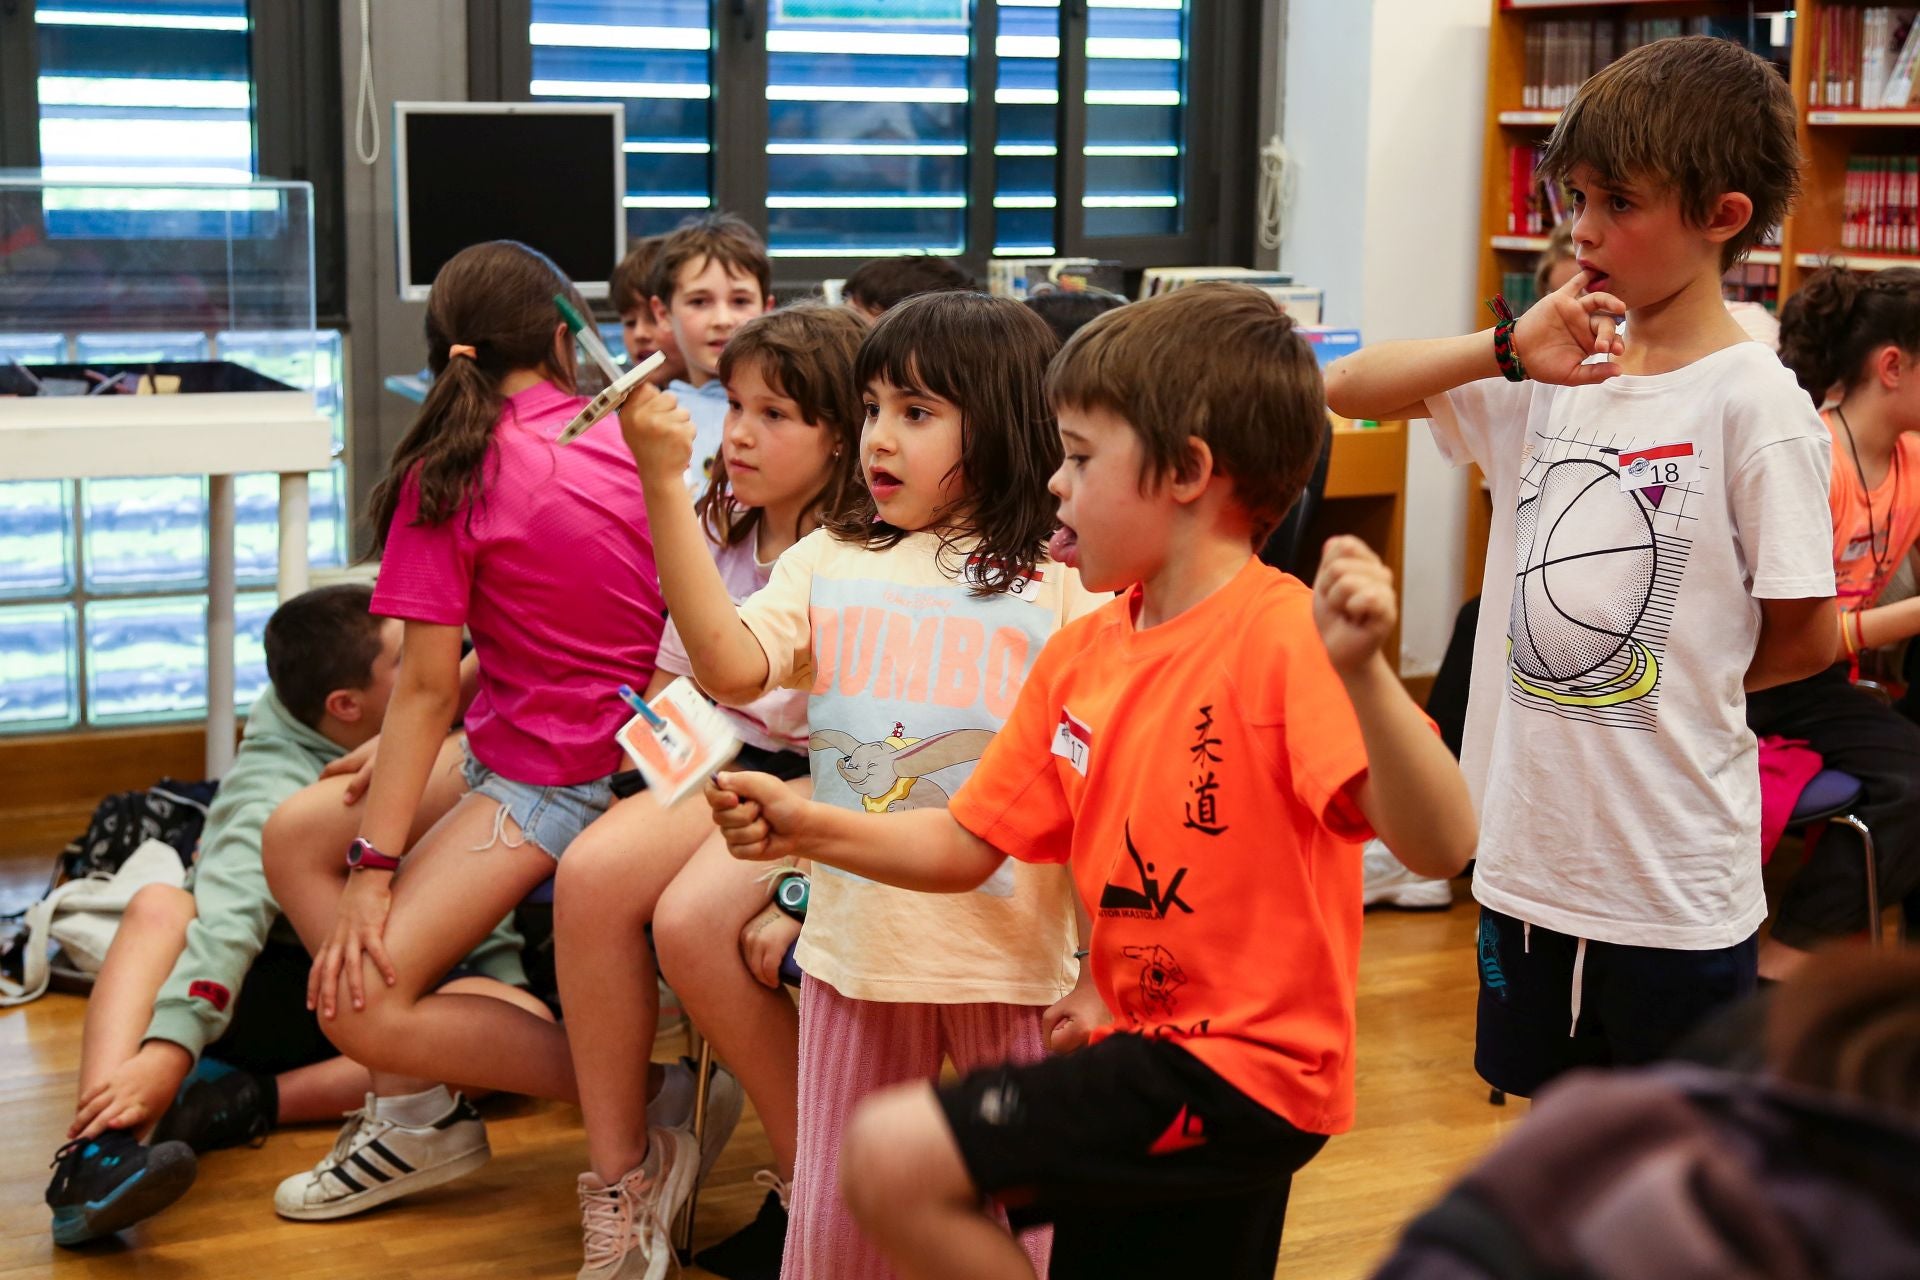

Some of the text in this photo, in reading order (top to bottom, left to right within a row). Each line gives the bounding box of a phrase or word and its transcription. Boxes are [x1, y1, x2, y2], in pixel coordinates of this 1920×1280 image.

[1650, 463, 1680, 485] 18
[810, 606, 1029, 720] DUMBO
[1071, 740, 1084, 767] 17
[1183, 704, 1230, 836] 柔道
